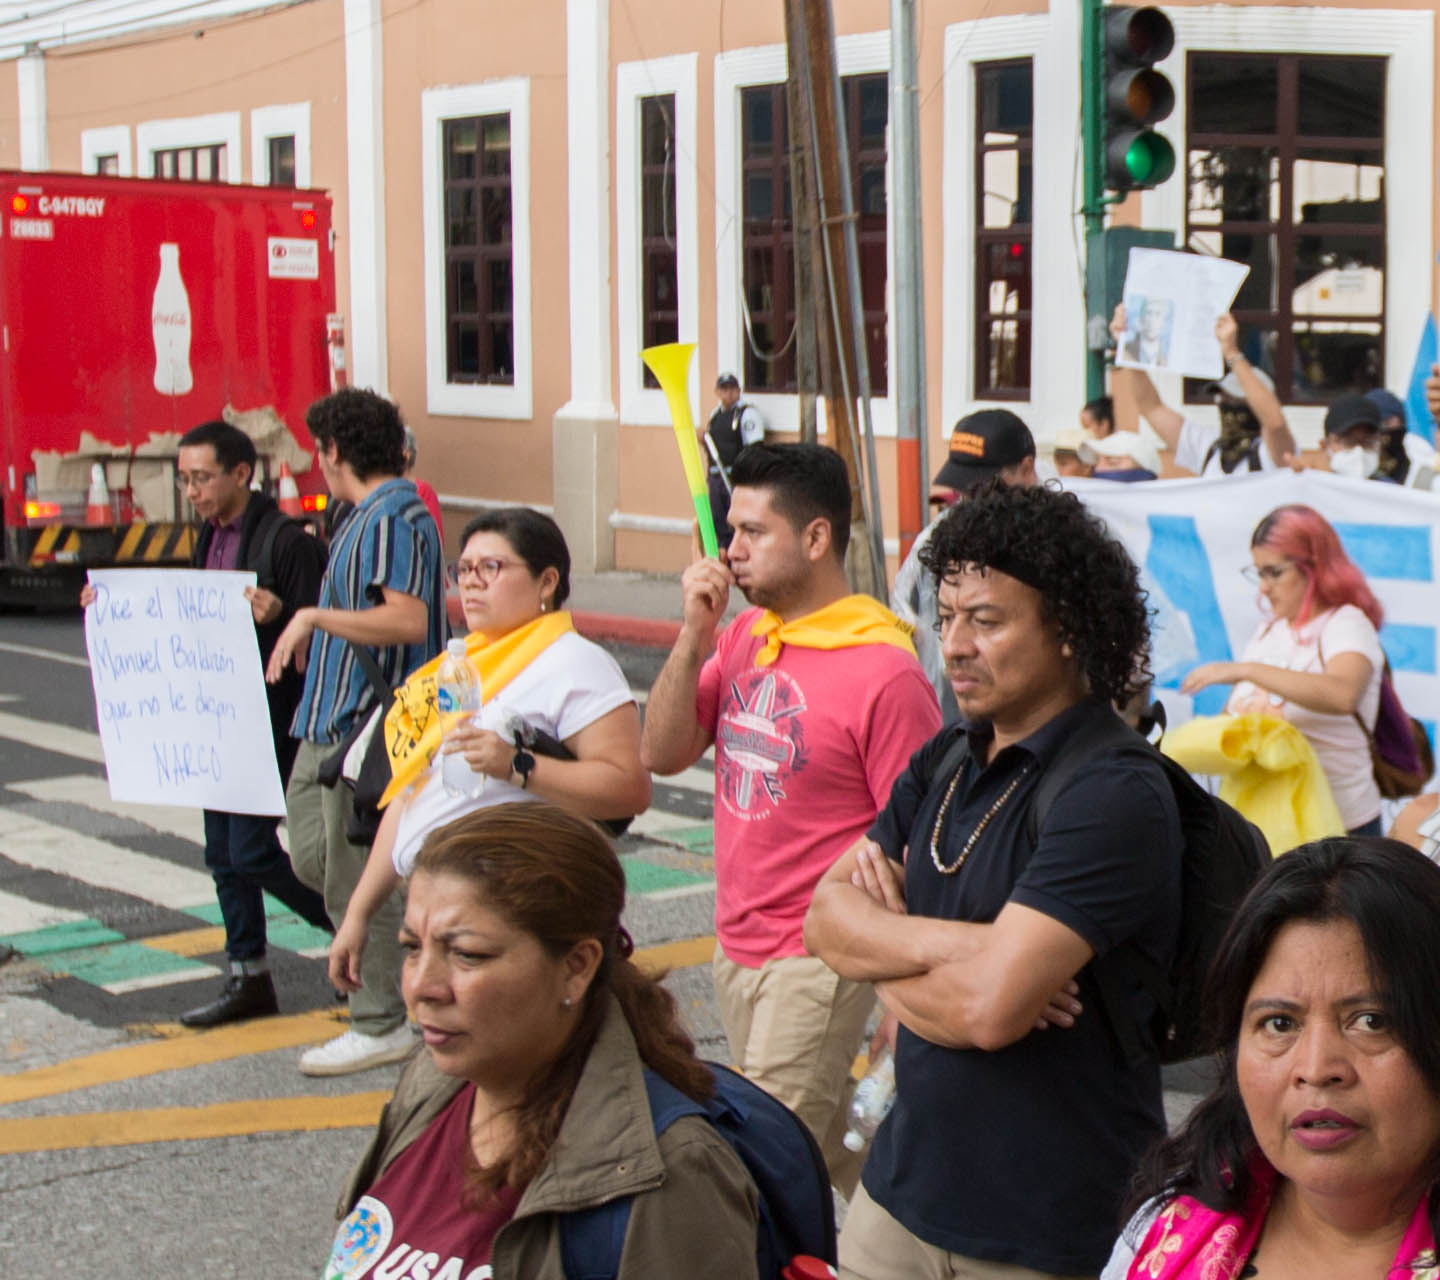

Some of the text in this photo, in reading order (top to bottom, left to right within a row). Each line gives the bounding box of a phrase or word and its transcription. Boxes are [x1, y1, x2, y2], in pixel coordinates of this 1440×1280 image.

[145, 587, 164, 619] el
[176, 585, 226, 623] NARCO
[93, 639, 161, 681] Manuel
[102, 698, 131, 742] que
[139, 697, 160, 715] no
[168, 681, 186, 714] le
[153, 742, 222, 787] NARCO
